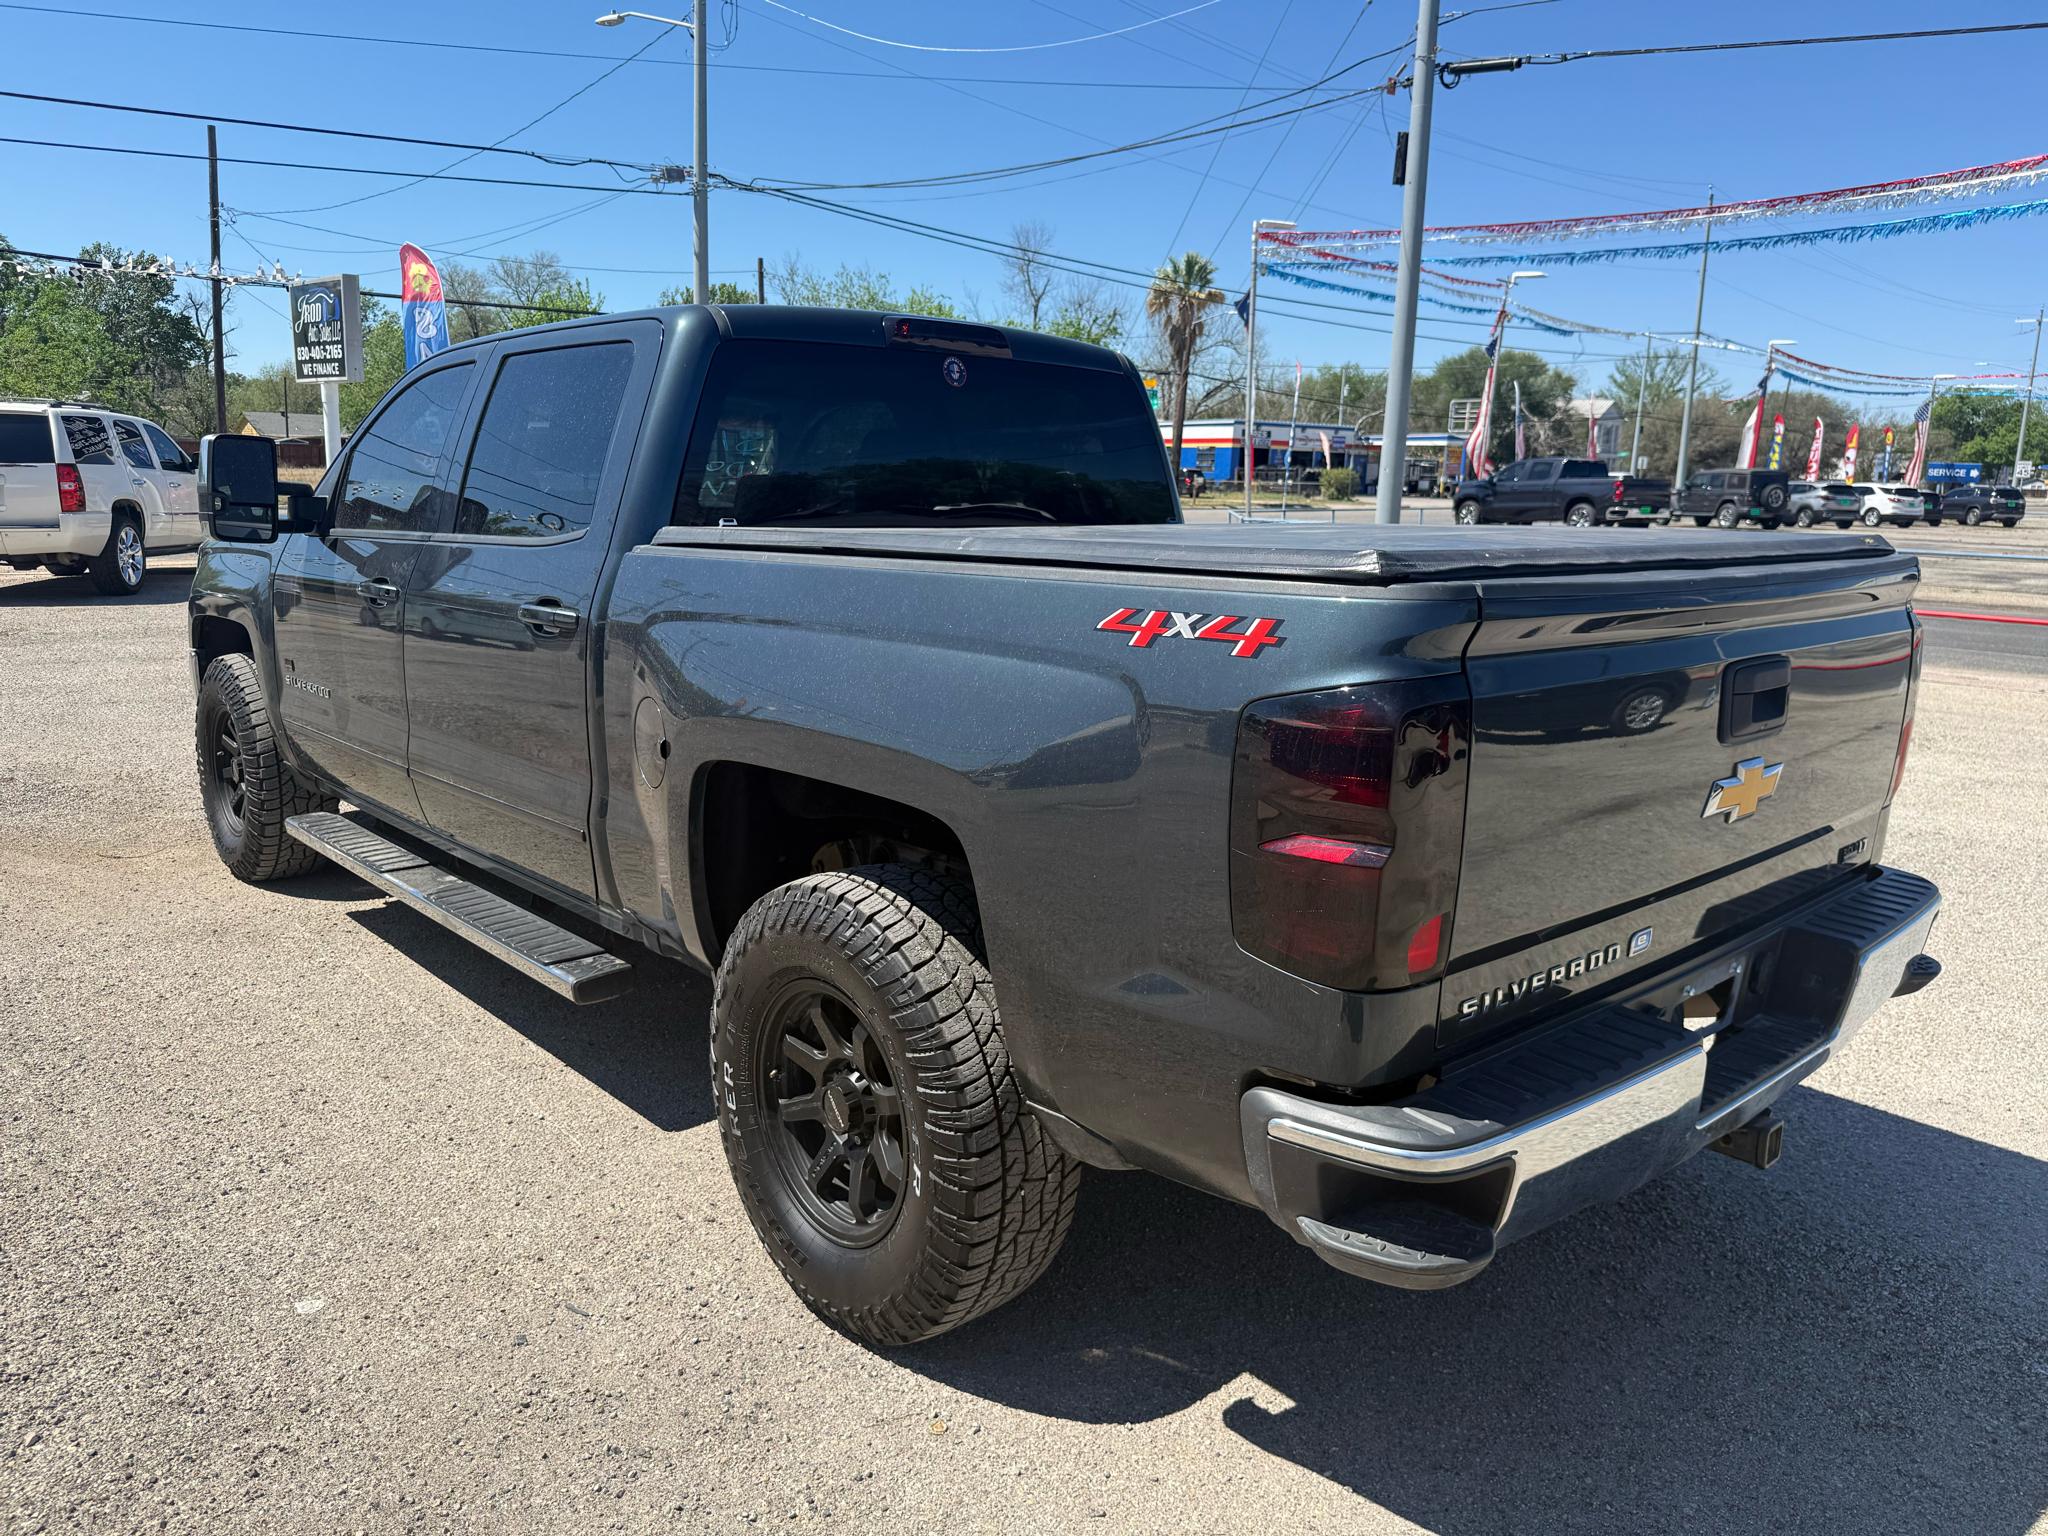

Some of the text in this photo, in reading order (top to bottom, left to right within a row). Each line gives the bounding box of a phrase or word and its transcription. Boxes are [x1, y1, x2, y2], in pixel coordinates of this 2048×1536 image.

[302, 362, 340, 375] WE FINANCE
[1928, 468, 1967, 478] SERVICE
[1457, 943, 1621, 1022] SILVERADO
